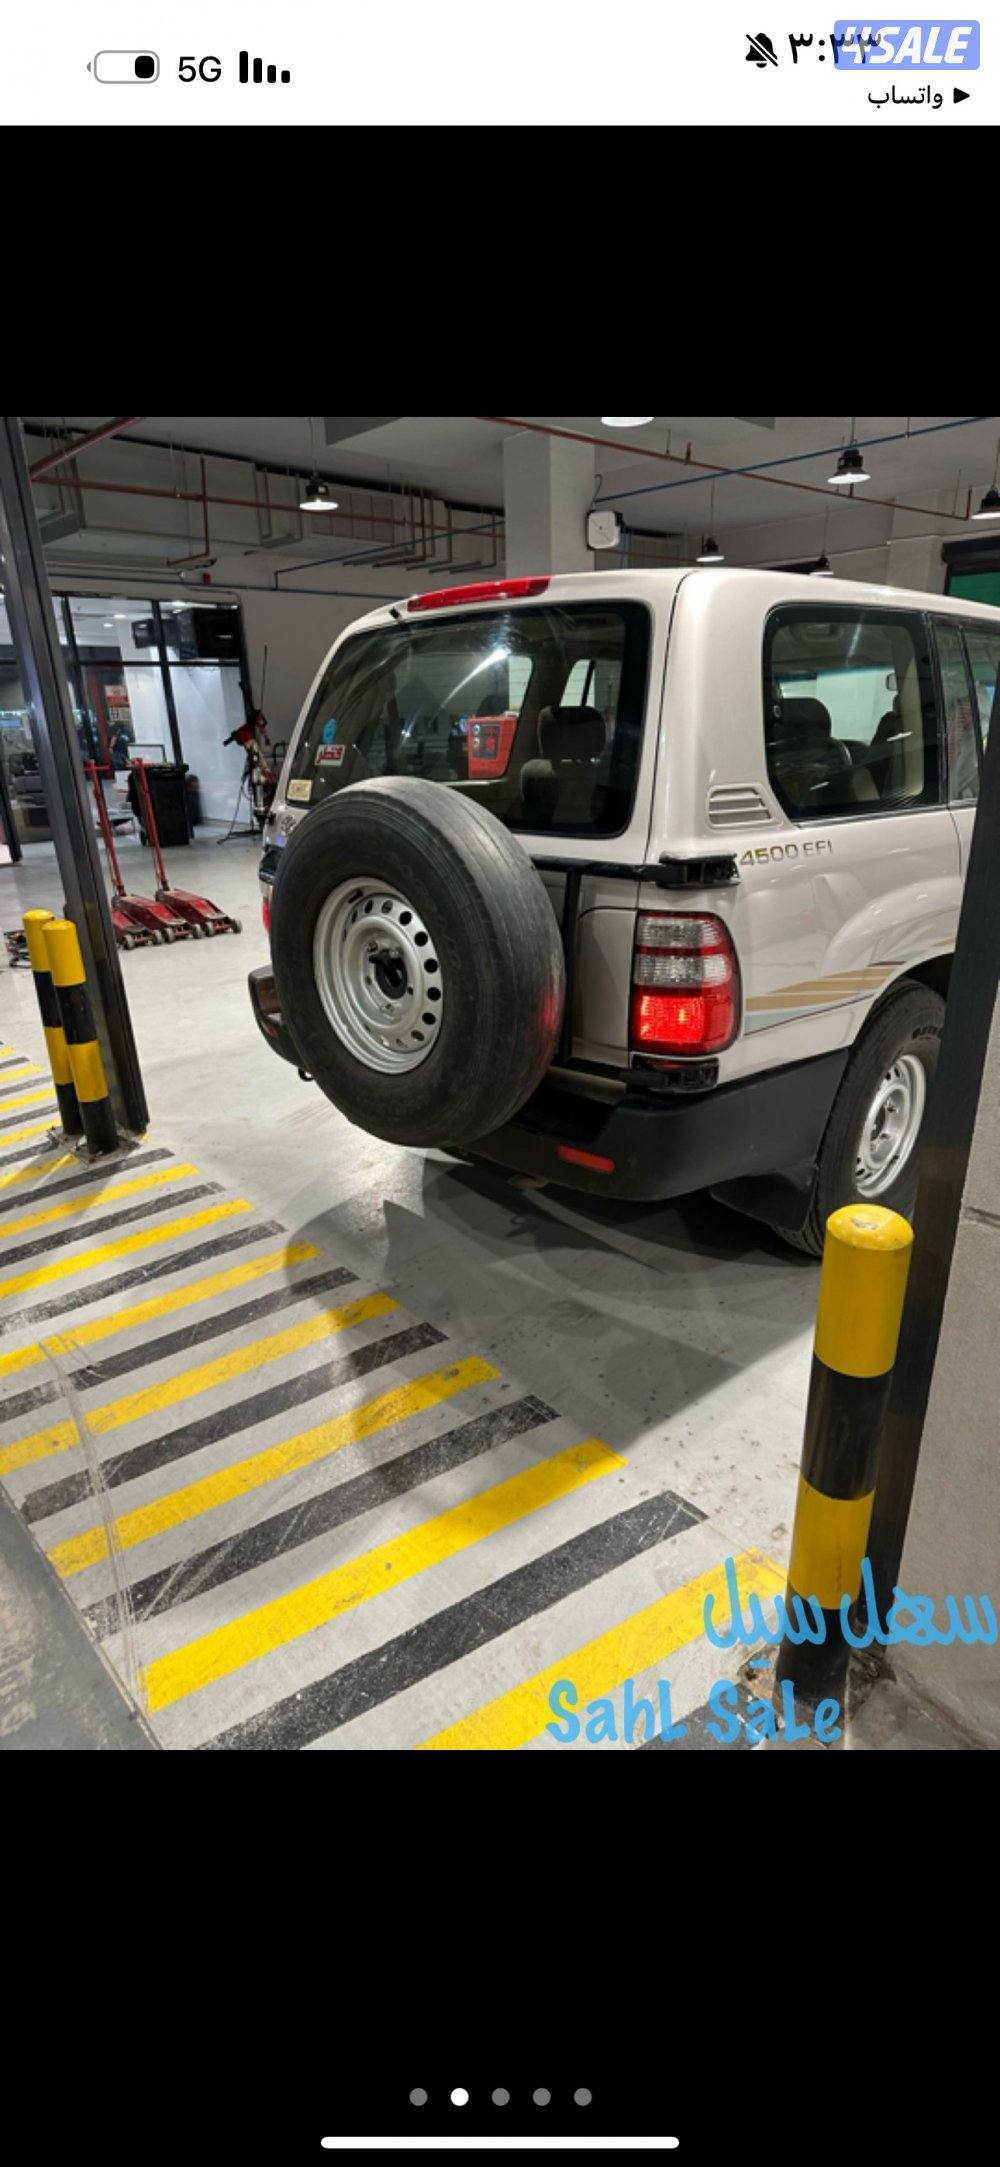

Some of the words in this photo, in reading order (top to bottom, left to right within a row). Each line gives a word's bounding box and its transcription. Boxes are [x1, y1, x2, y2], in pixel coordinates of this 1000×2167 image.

[178, 56, 222, 83] 5G
[867, 84, 943, 109] واتساب
[740, 842, 799, 866] 4500
[802, 839, 833, 857] EFI
